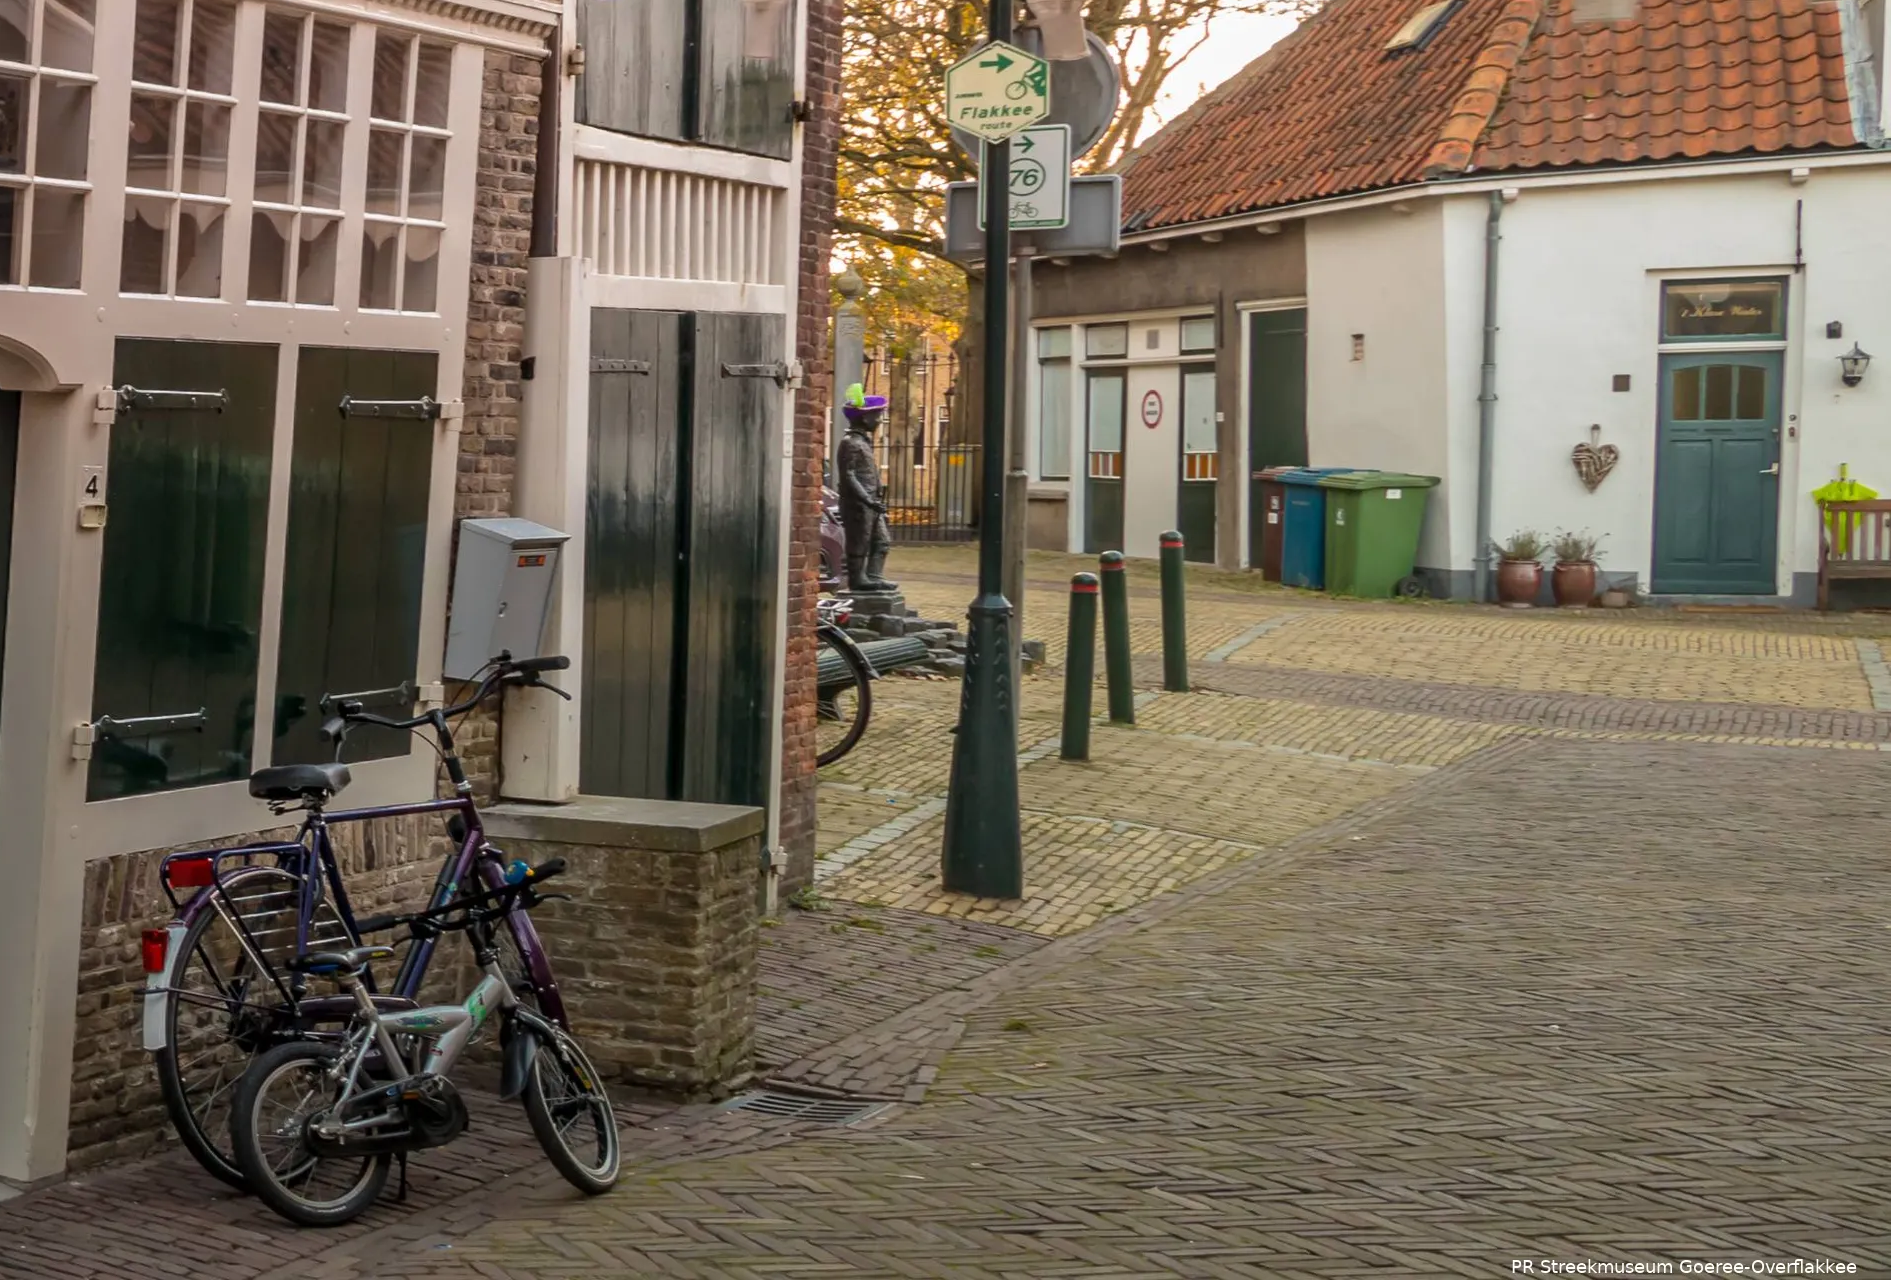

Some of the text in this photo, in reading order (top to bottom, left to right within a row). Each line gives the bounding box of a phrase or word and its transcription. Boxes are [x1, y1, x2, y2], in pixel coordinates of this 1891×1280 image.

[959, 104, 1034, 120] Flakkee
[979, 121, 1013, 131] route
[1009, 168, 1039, 187] 76
[85, 474, 98, 498] 4
